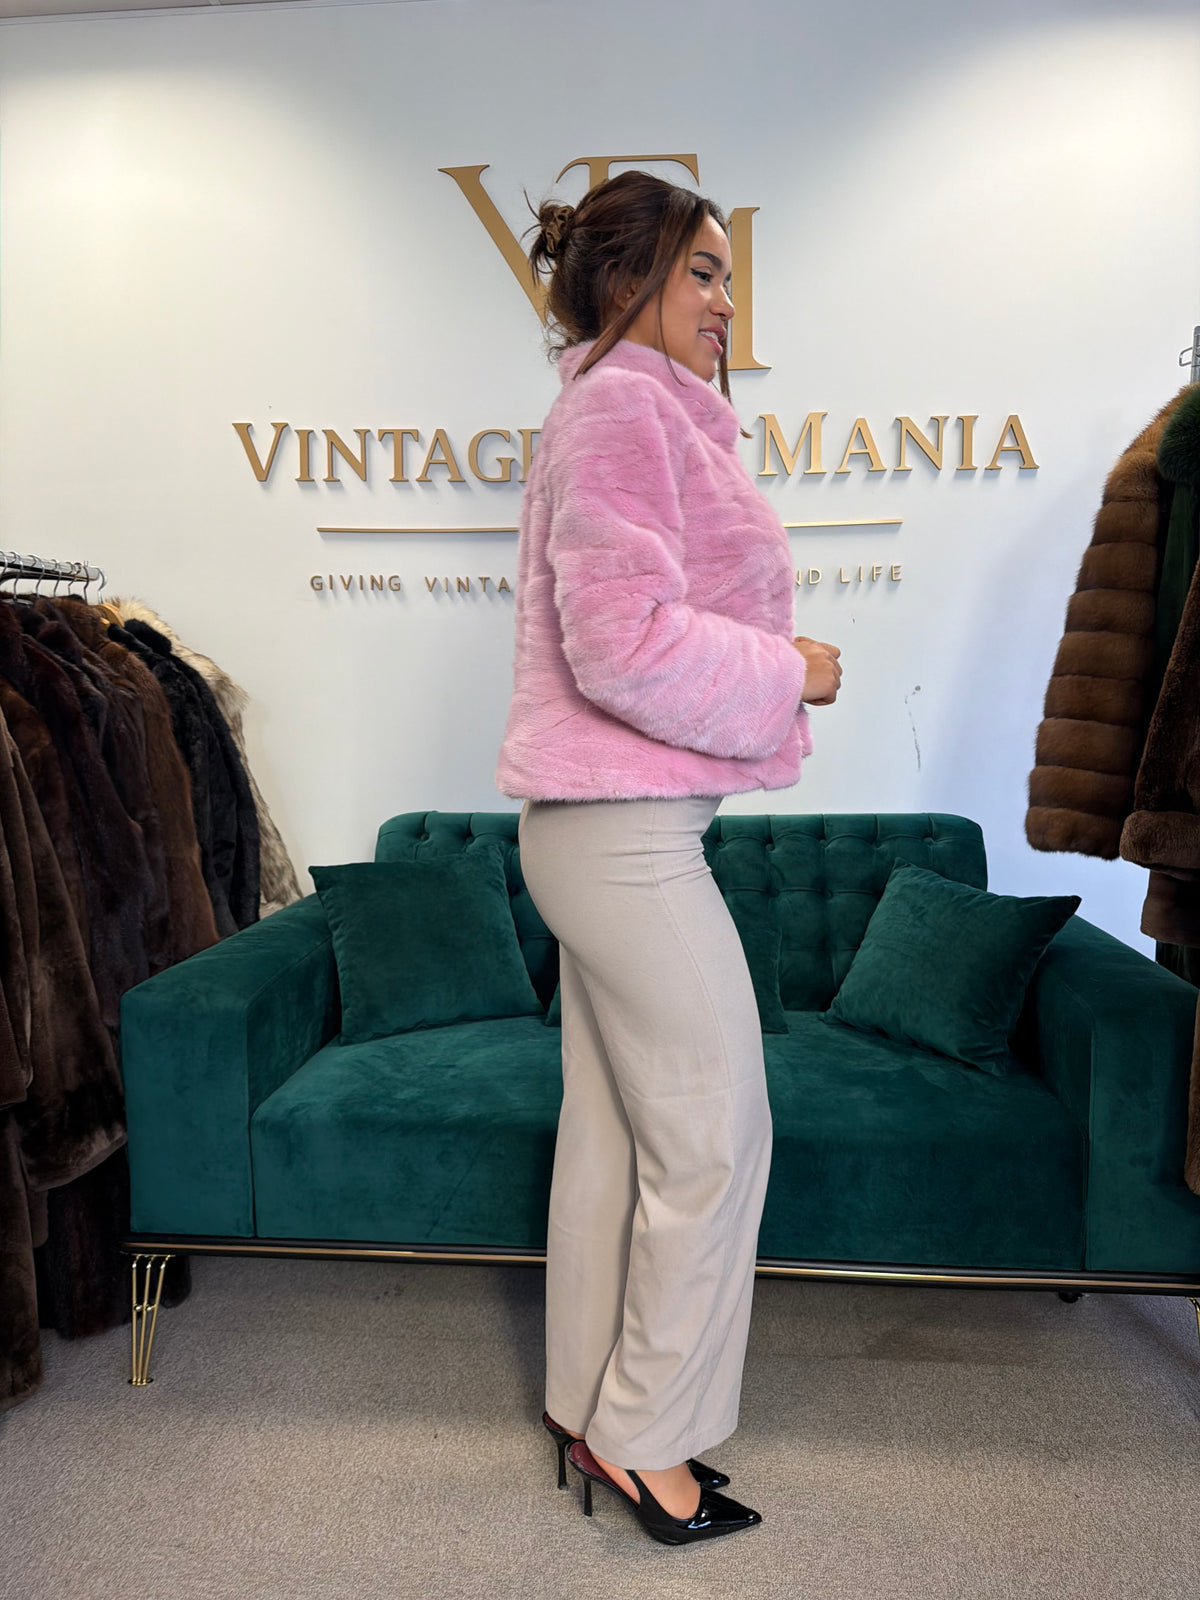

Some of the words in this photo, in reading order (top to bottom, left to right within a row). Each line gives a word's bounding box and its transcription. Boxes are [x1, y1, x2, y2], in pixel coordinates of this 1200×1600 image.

[757, 411, 1040, 476] MANIA
[309, 574, 402, 592] GIVING
[424, 575, 512, 592] VINTA
[839, 564, 903, 584] LIFE
